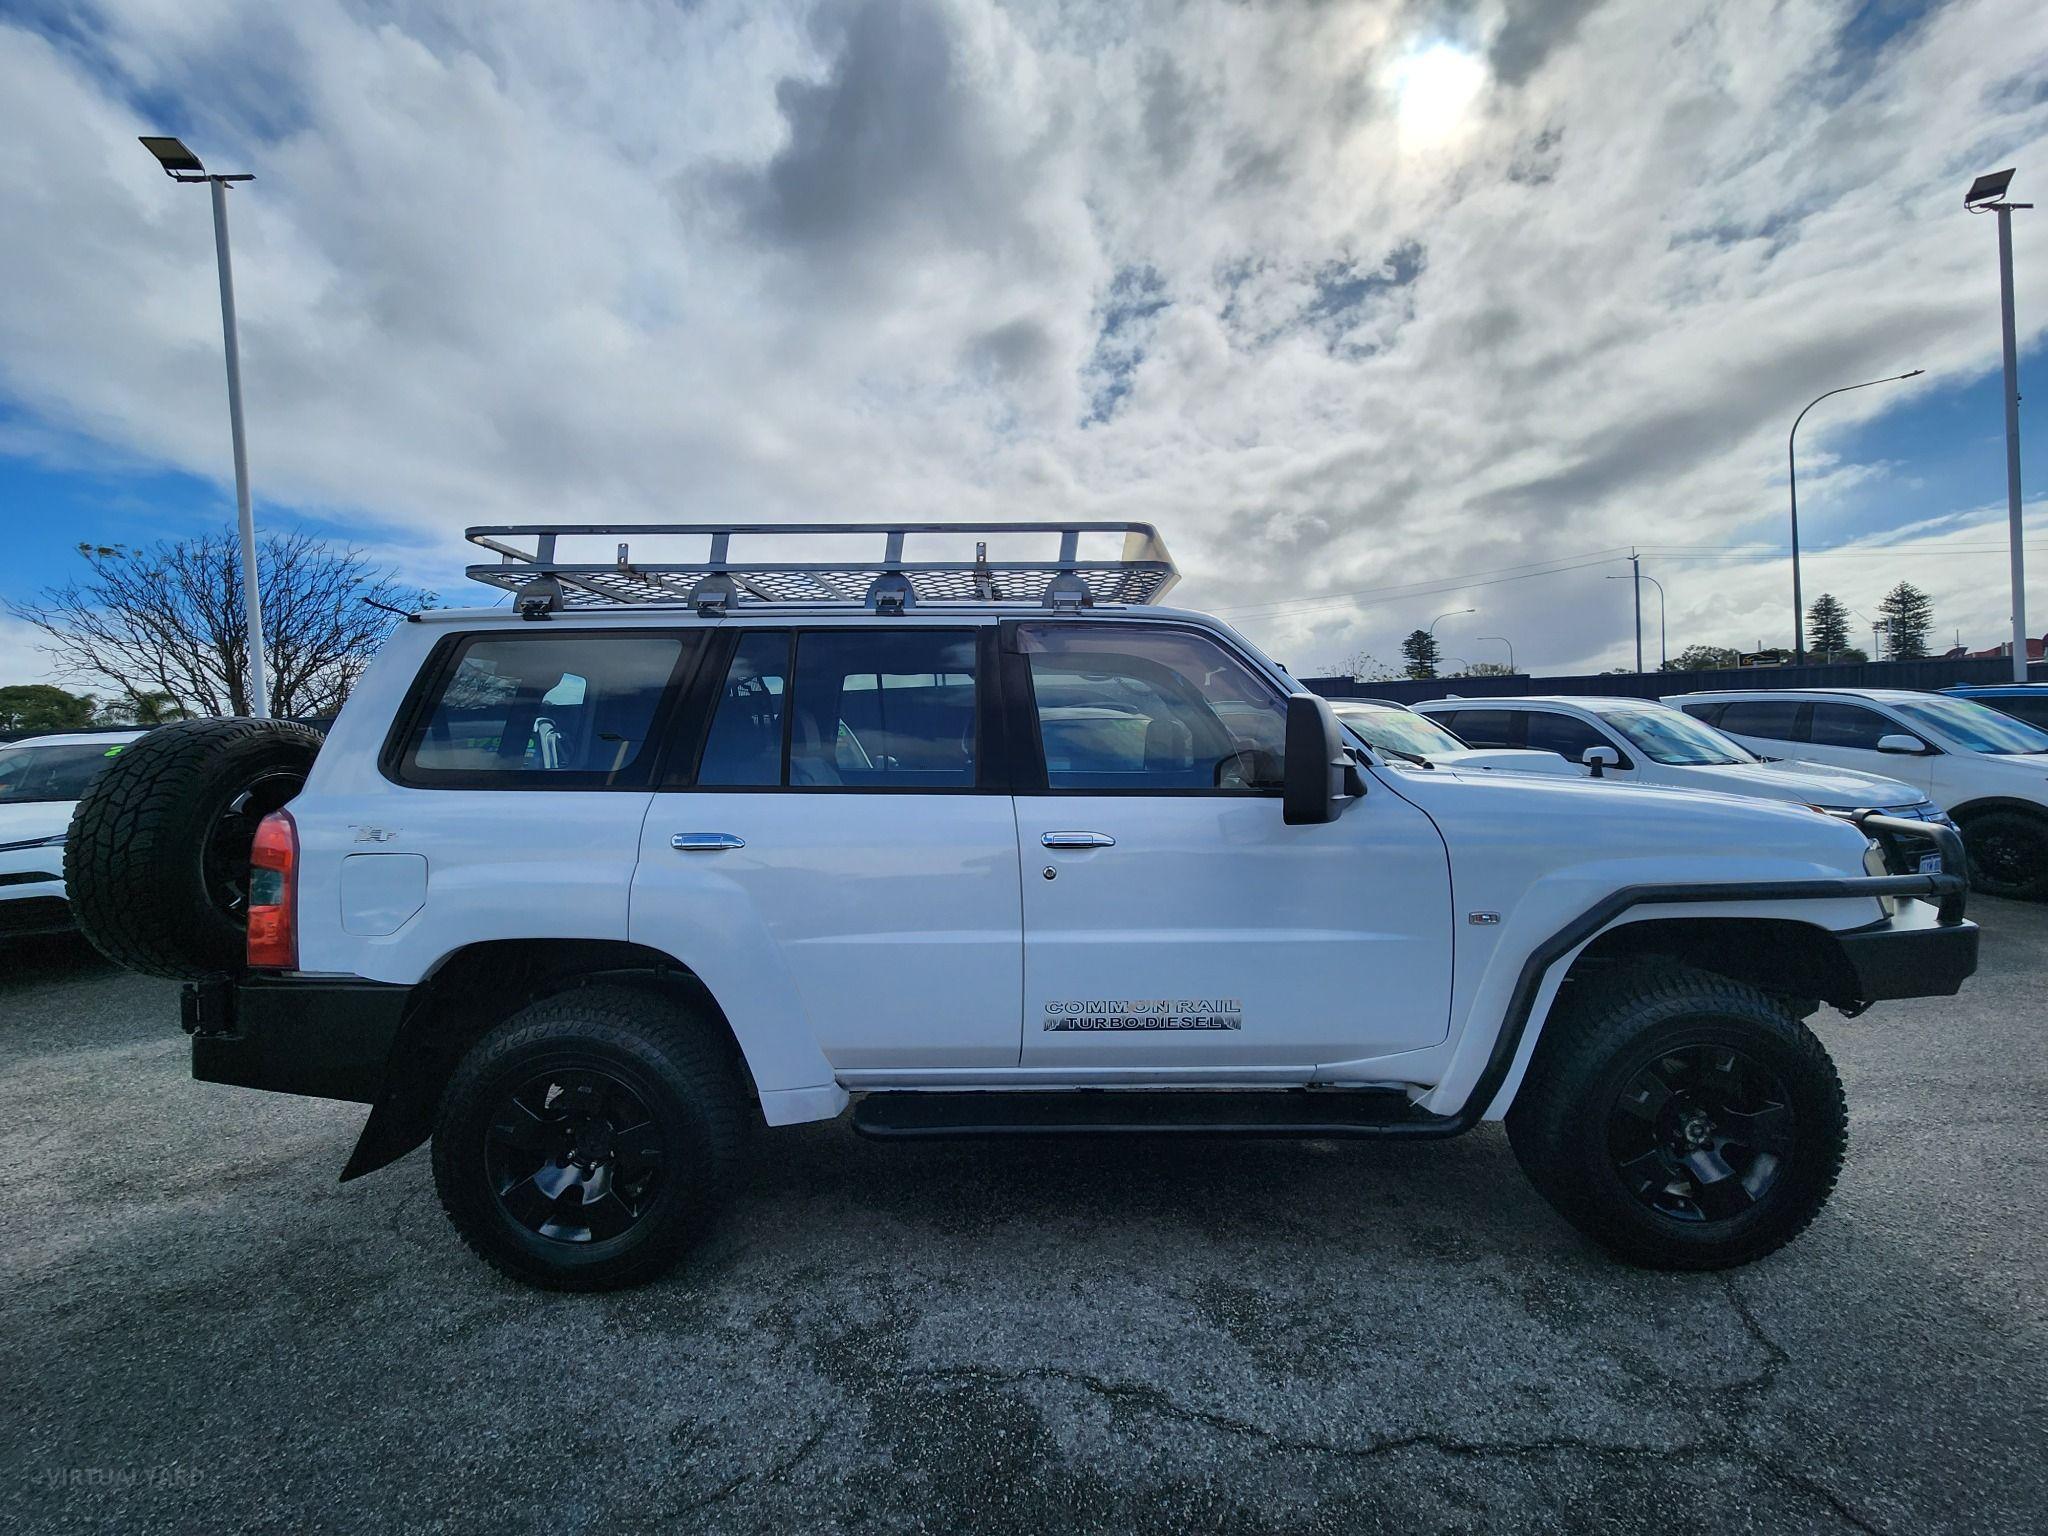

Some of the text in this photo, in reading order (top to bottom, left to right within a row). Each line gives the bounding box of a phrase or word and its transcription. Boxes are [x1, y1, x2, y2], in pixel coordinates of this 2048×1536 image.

[1044, 1000, 1241, 1014] COMMON RAIL
[1065, 1016, 1222, 1030] TURBO DIESEL
